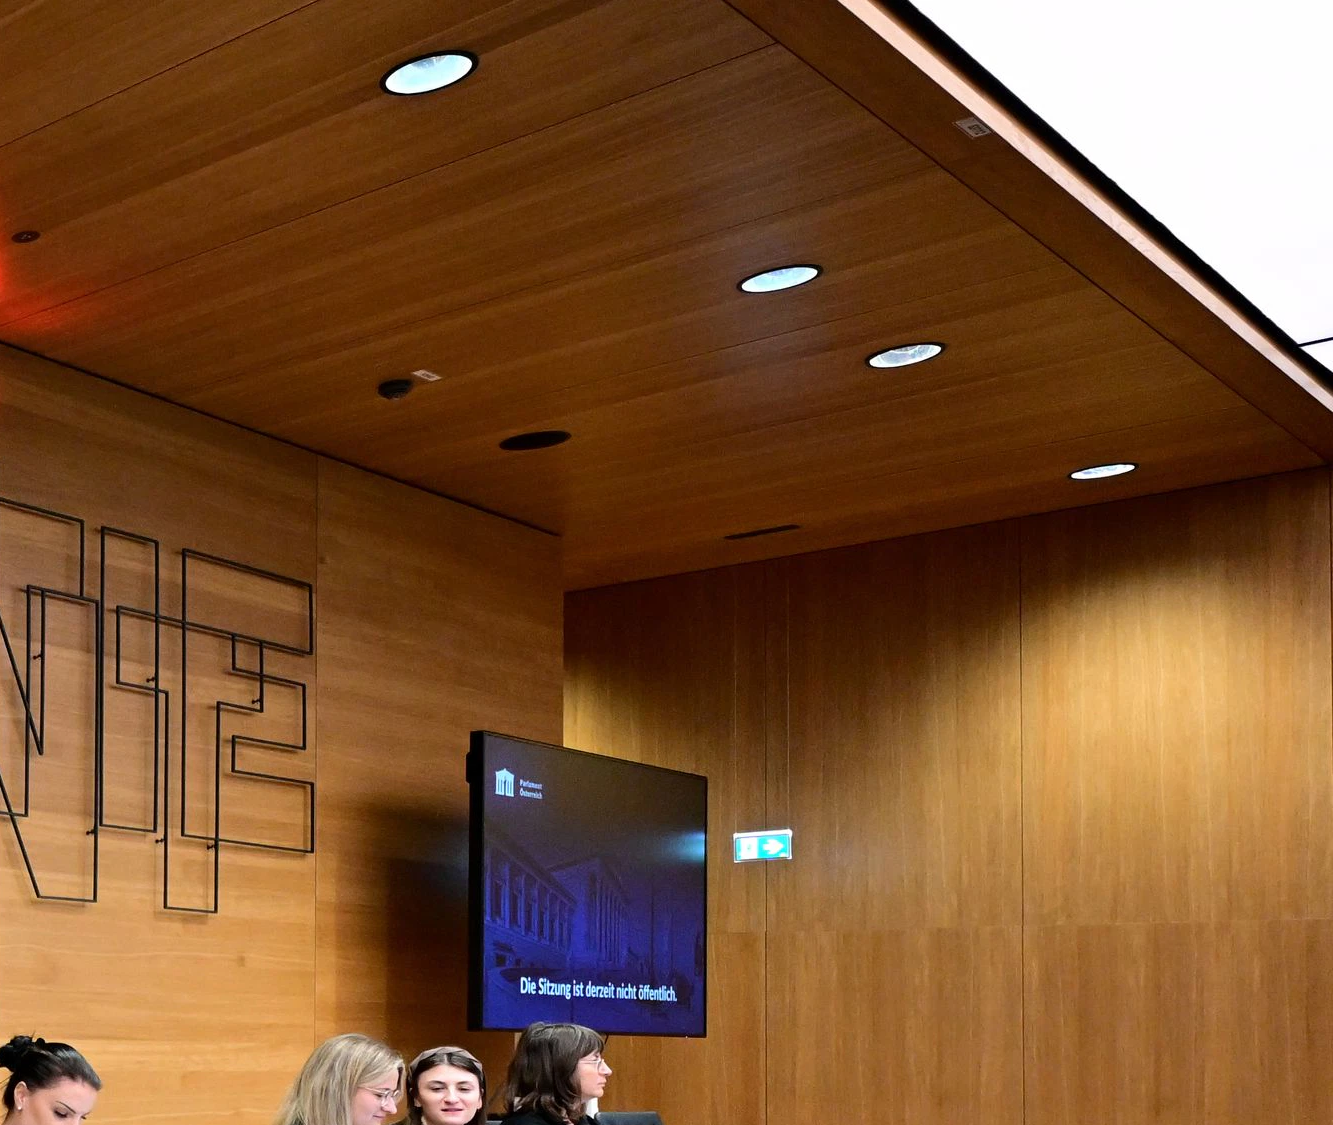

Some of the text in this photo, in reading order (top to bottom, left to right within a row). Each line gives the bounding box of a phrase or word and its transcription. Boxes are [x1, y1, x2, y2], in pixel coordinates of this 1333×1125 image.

[520, 976, 678, 1002] Die Sitzung ist derzeit nicht öffentlich.
